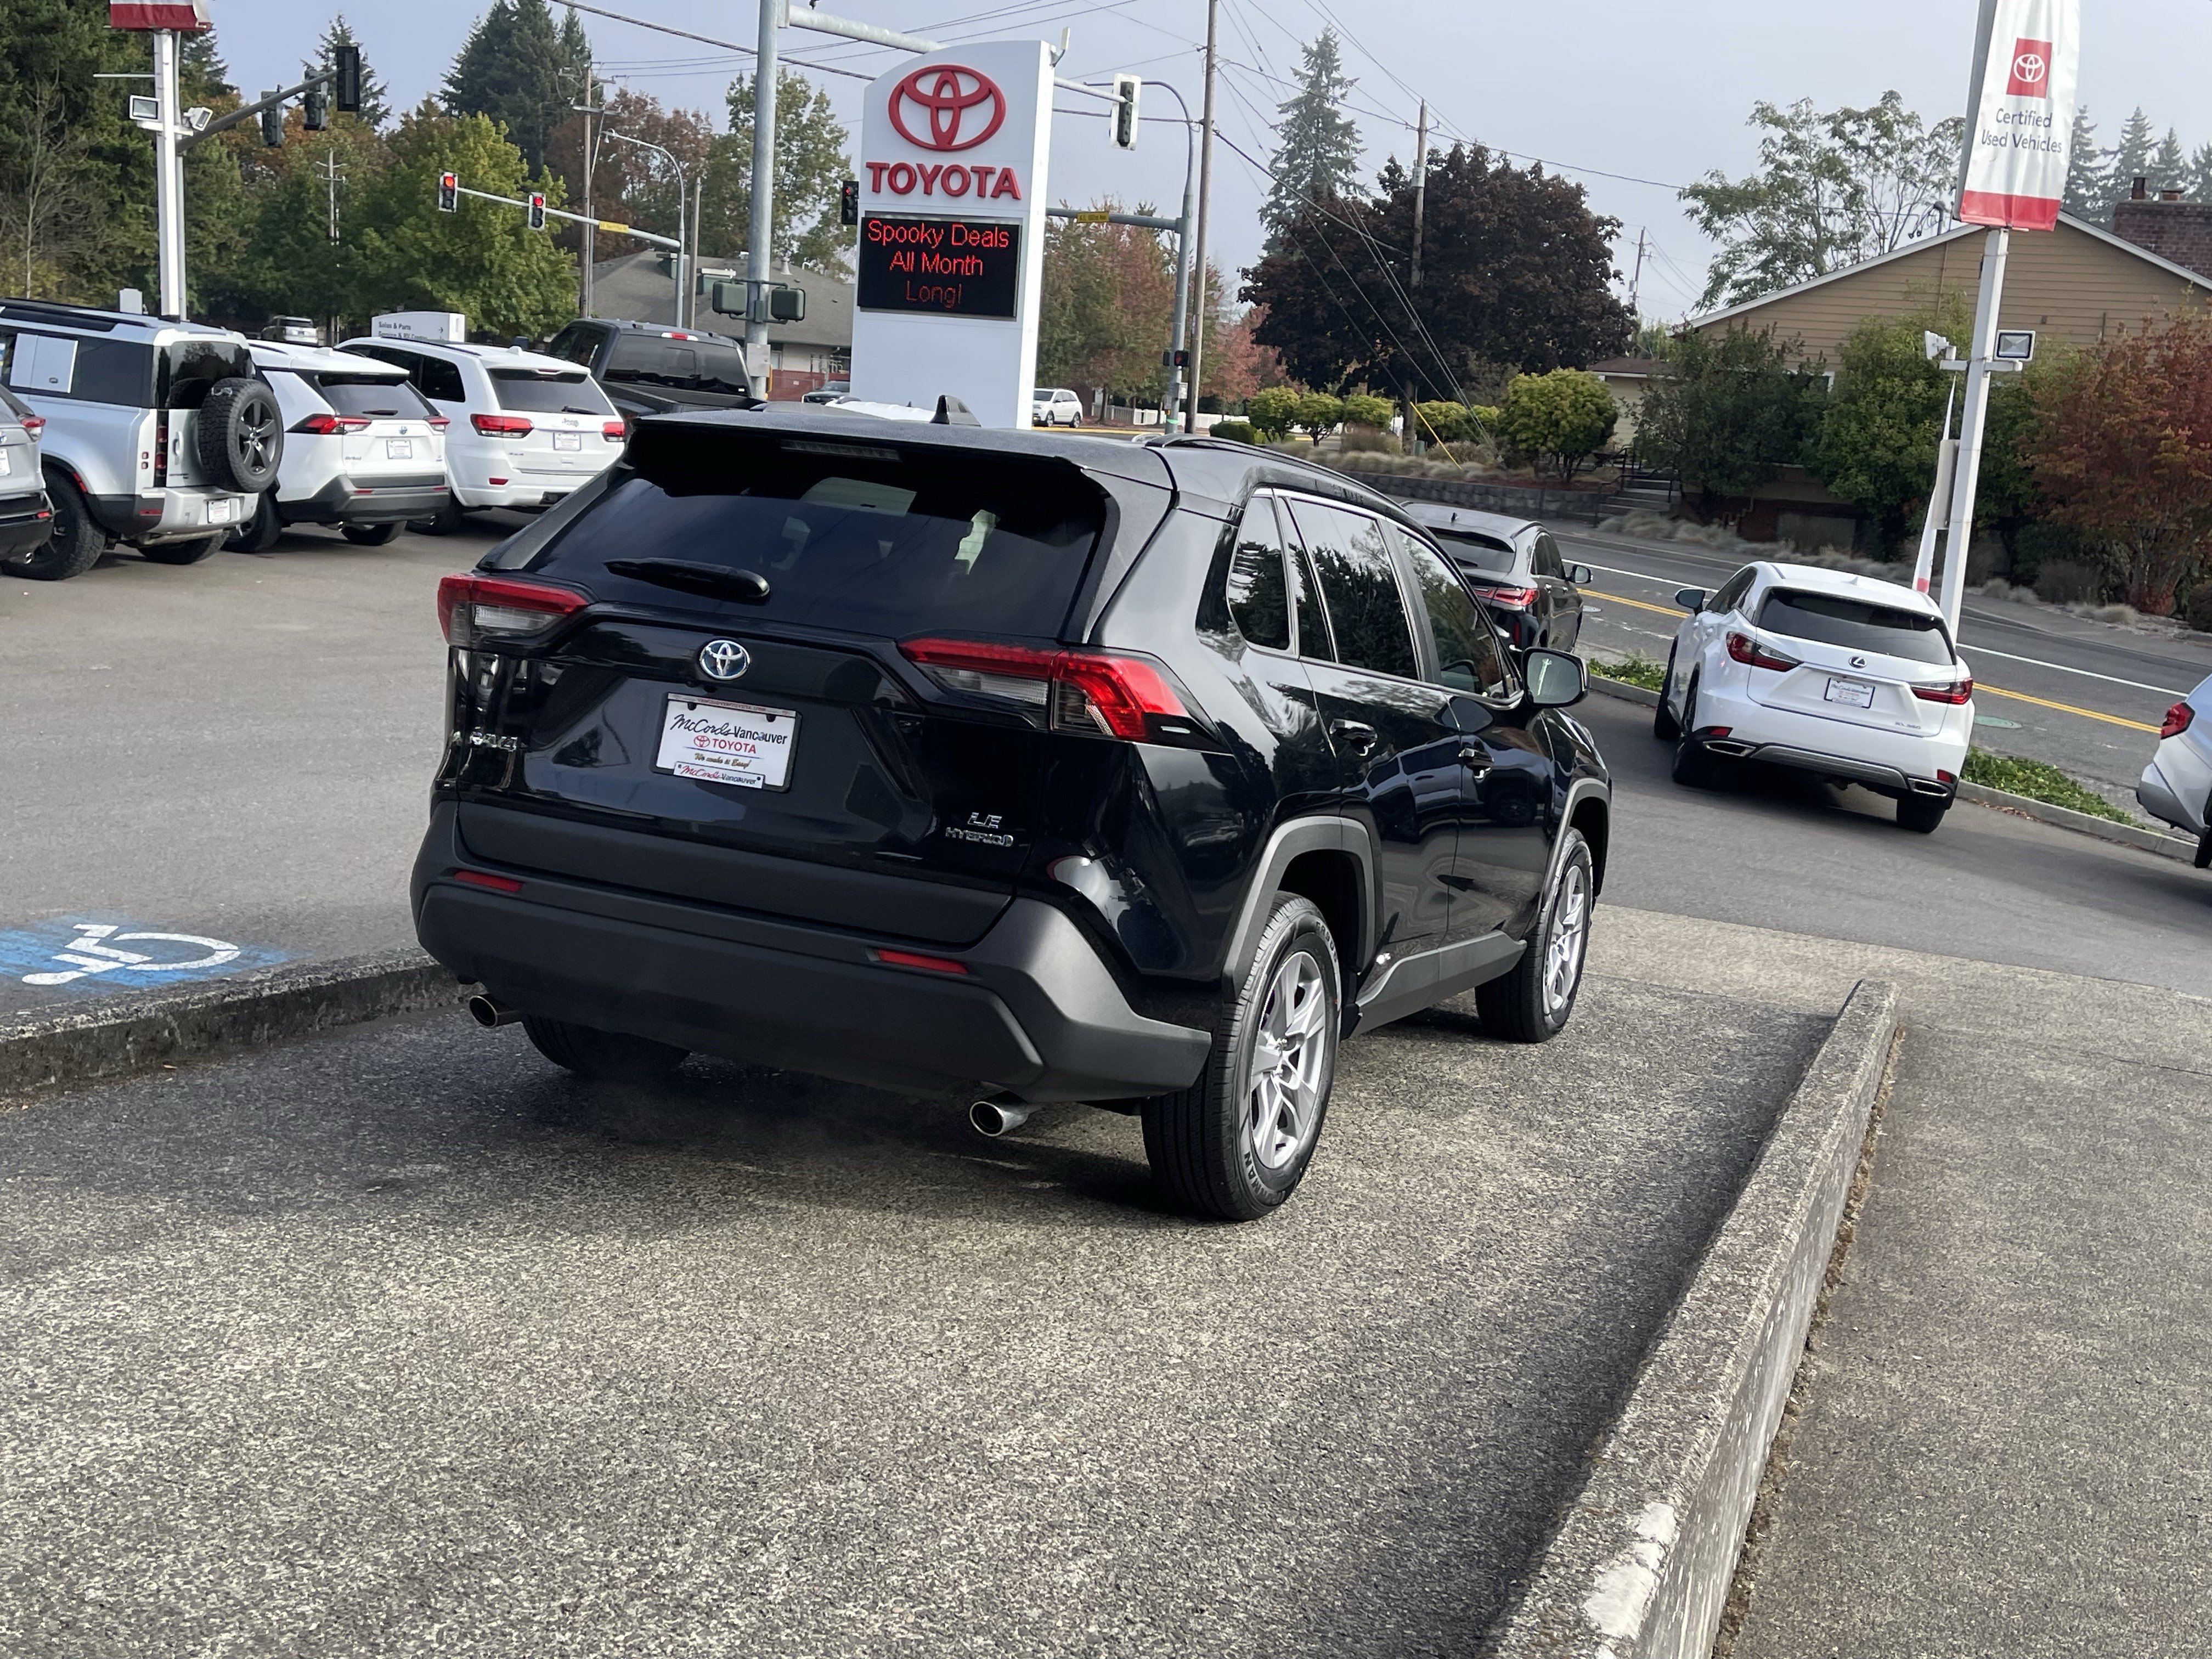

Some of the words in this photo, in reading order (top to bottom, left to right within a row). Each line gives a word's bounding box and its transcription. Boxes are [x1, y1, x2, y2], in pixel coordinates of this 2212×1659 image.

[1996, 108, 2053, 128] Certified
[1982, 129, 2008, 147] Used
[2012, 133, 2062, 153] Vehicles
[866, 162, 1021, 200] TOYOTA
[868, 219, 944, 249] Spooky
[951, 223, 1009, 247] Deals
[889, 251, 915, 271] All
[922, 252, 983, 275] Month
[712, 738, 757, 754] TOYOTA
